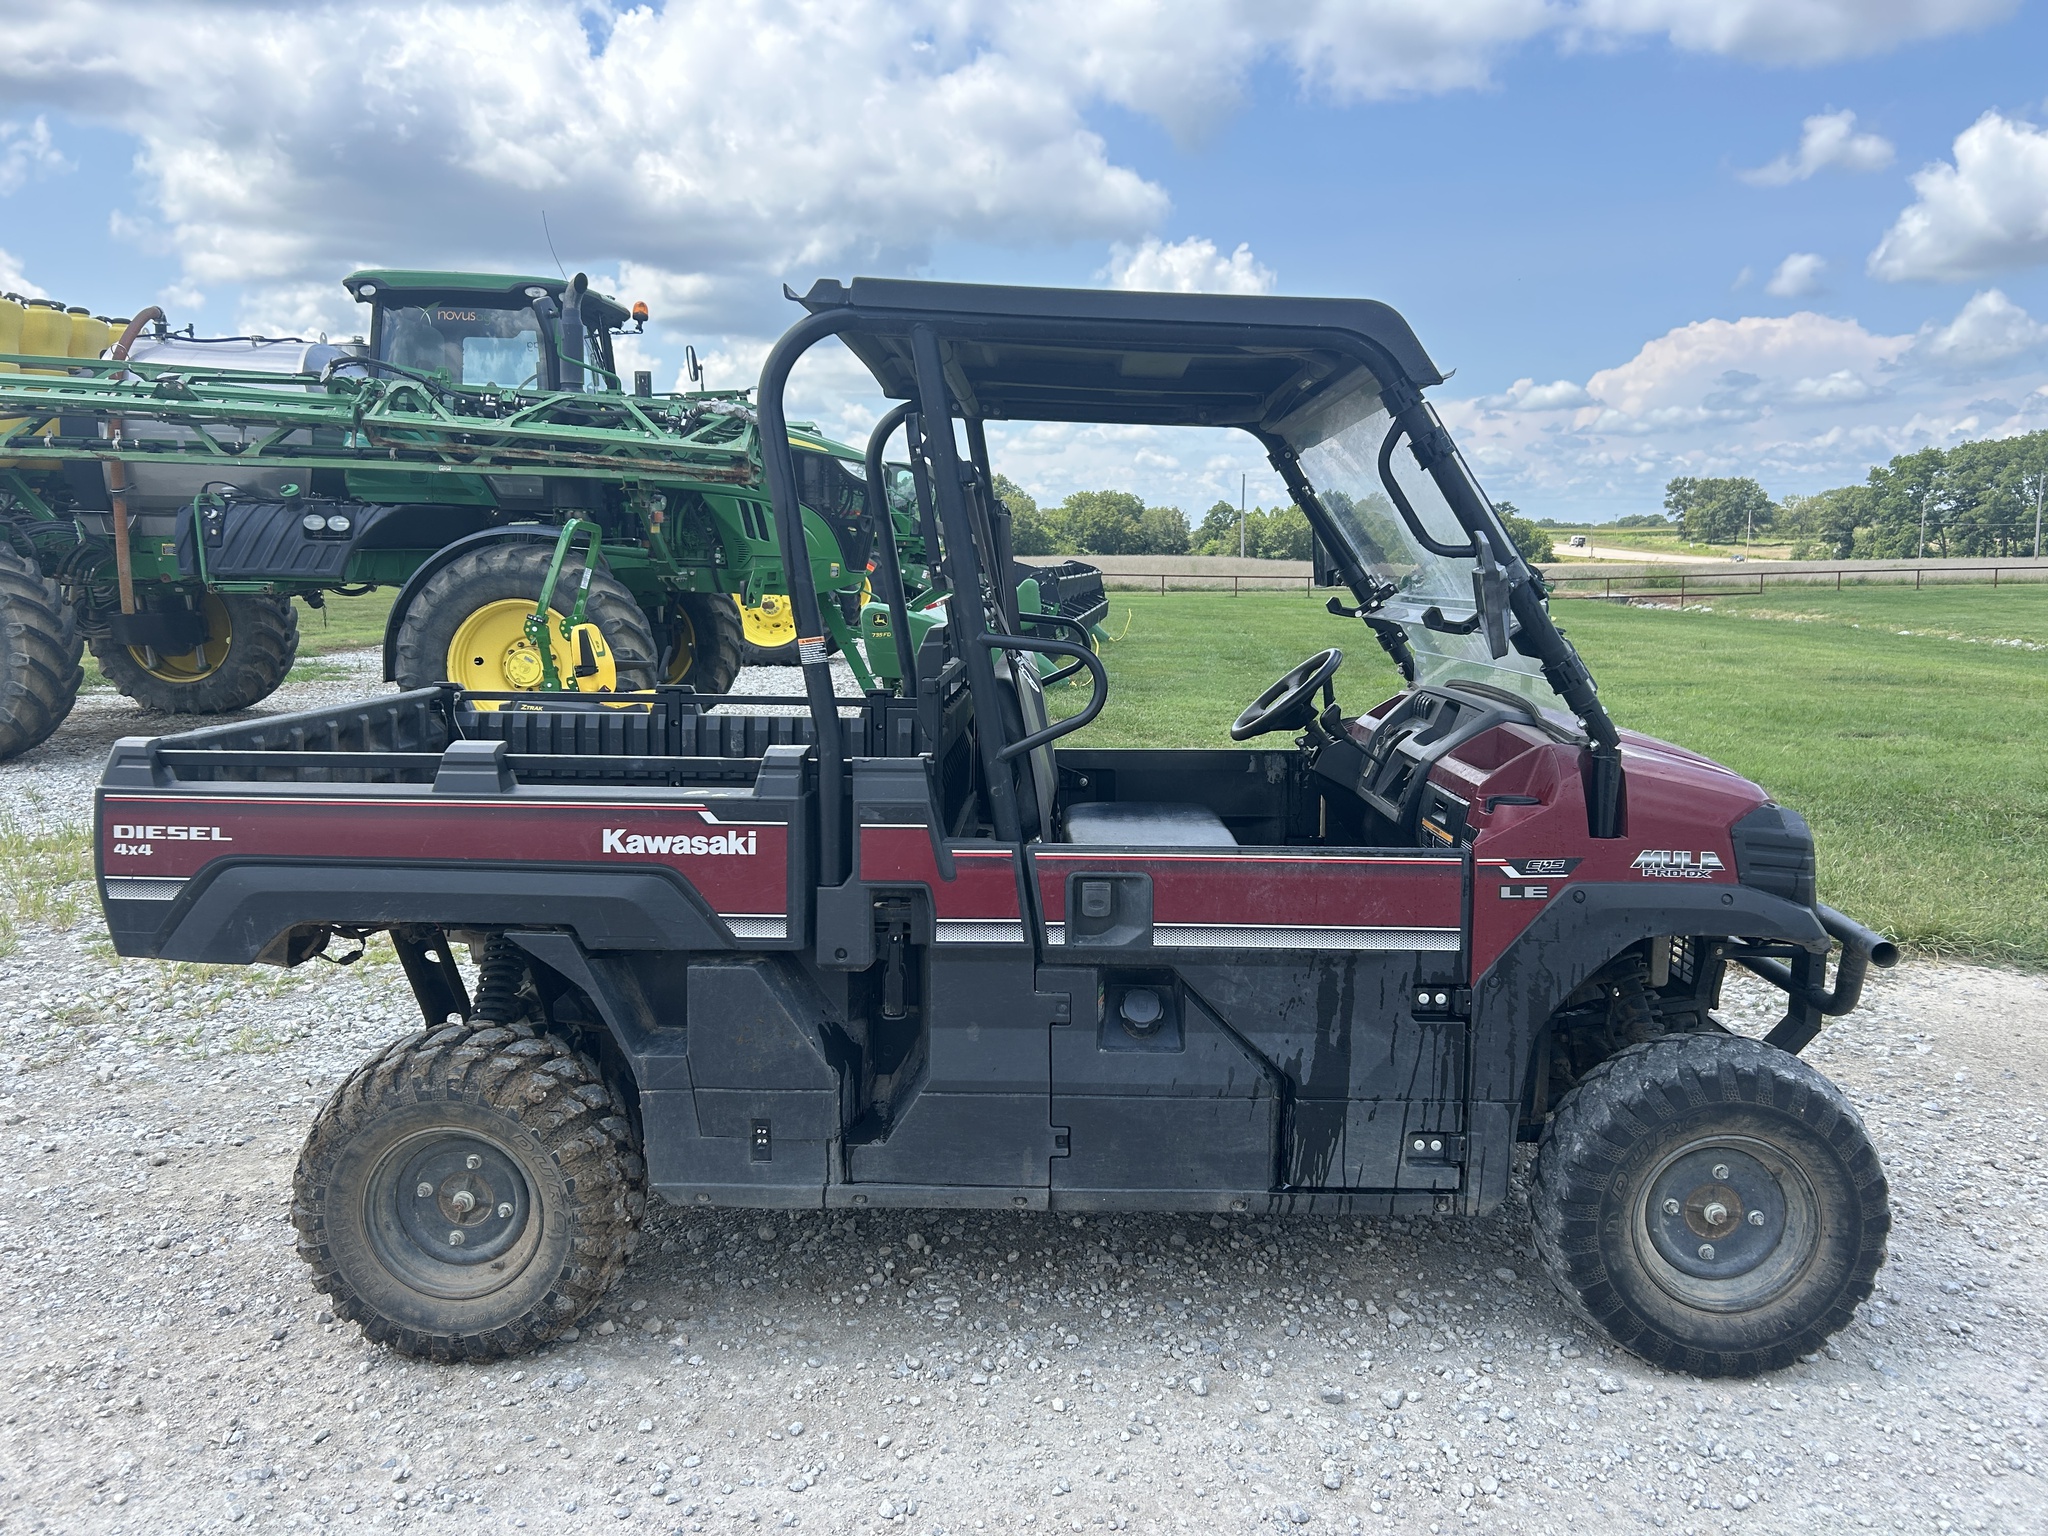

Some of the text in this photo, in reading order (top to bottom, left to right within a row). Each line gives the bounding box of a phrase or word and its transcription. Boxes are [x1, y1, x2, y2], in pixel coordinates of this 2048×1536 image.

[113, 825, 233, 841] DIESEL
[113, 843, 154, 856] 4x4
[602, 829, 757, 855] Kawasaki
[1630, 850, 1726, 871] MULE
[1642, 869, 1712, 879] PRO-DX
[1501, 887, 1548, 898] LE
[511, 1134, 567, 1235] DURO
